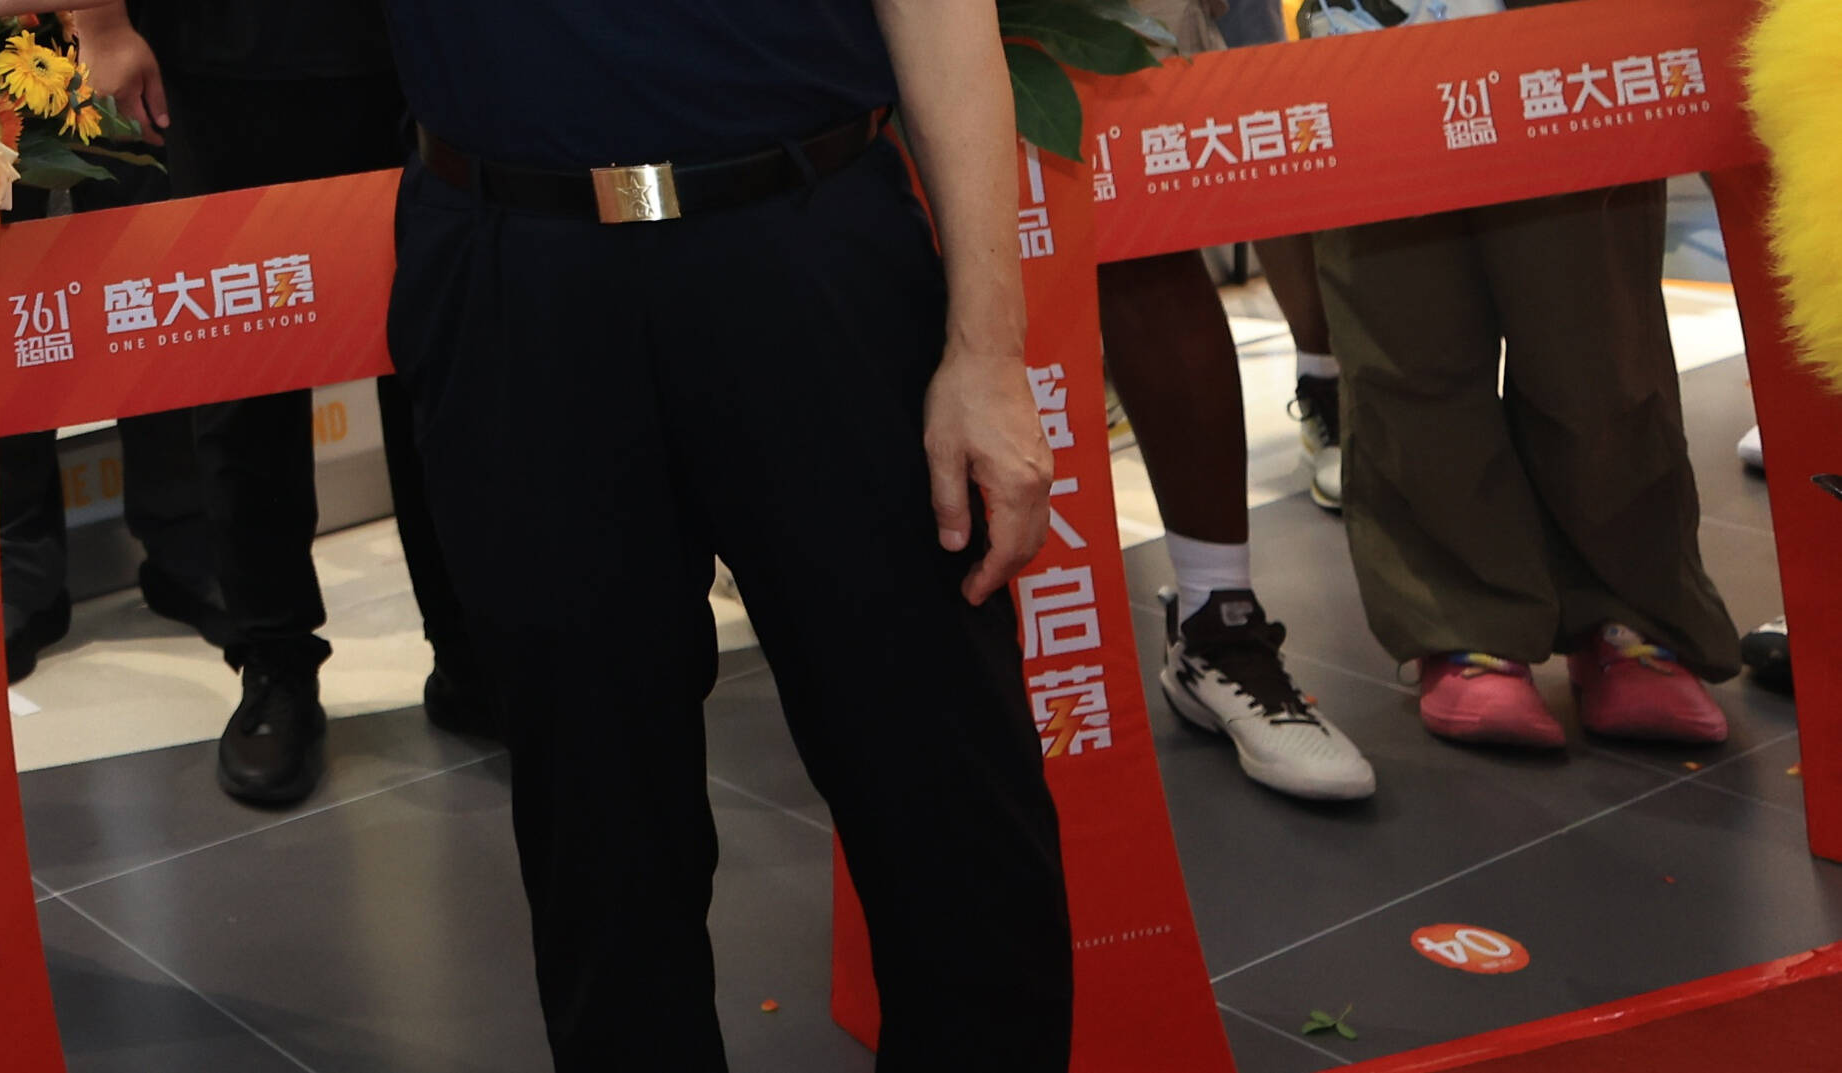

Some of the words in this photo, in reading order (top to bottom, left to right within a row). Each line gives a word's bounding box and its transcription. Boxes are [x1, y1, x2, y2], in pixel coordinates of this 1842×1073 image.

[1436, 70, 1500, 123] 361°
[1443, 115, 1498, 150] 超品
[1527, 124, 1560, 139] ONE
[1570, 112, 1635, 132] DEGREE
[1645, 100, 1711, 119] BEYOND
[1147, 180, 1182, 195] ONE
[1192, 167, 1259, 188] DEGREE
[1269, 154, 1338, 177] BEYOND
[8, 281, 82, 338] 361°
[14, 331, 74, 369] 超品
[109, 336, 146, 354] ONE
[158, 323, 232, 347] DEGREE
[243, 310, 318, 333] BEYOND
